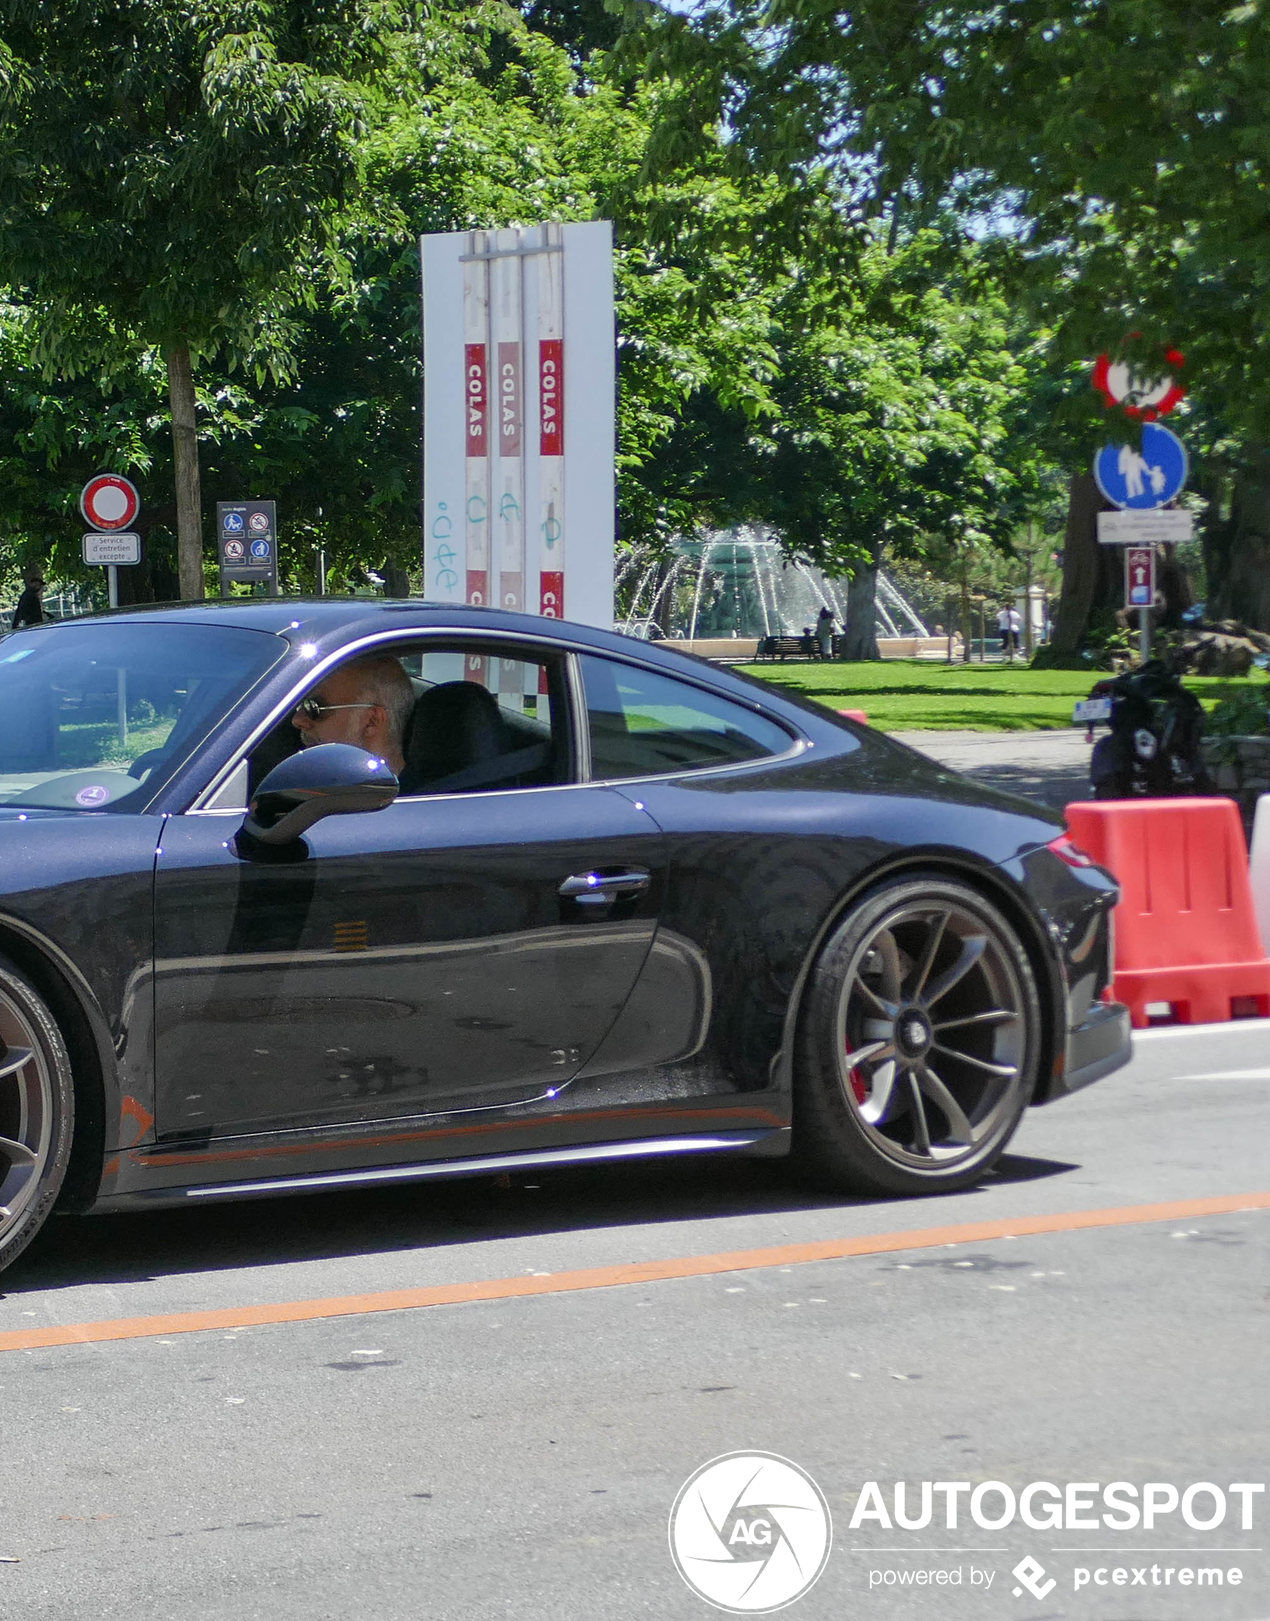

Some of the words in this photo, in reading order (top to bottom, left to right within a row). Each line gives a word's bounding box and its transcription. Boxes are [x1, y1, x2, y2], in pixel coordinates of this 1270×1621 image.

[469, 365, 482, 436] COLAS
[502, 363, 515, 436] COLAS
[542, 360, 556, 434] COLAS
